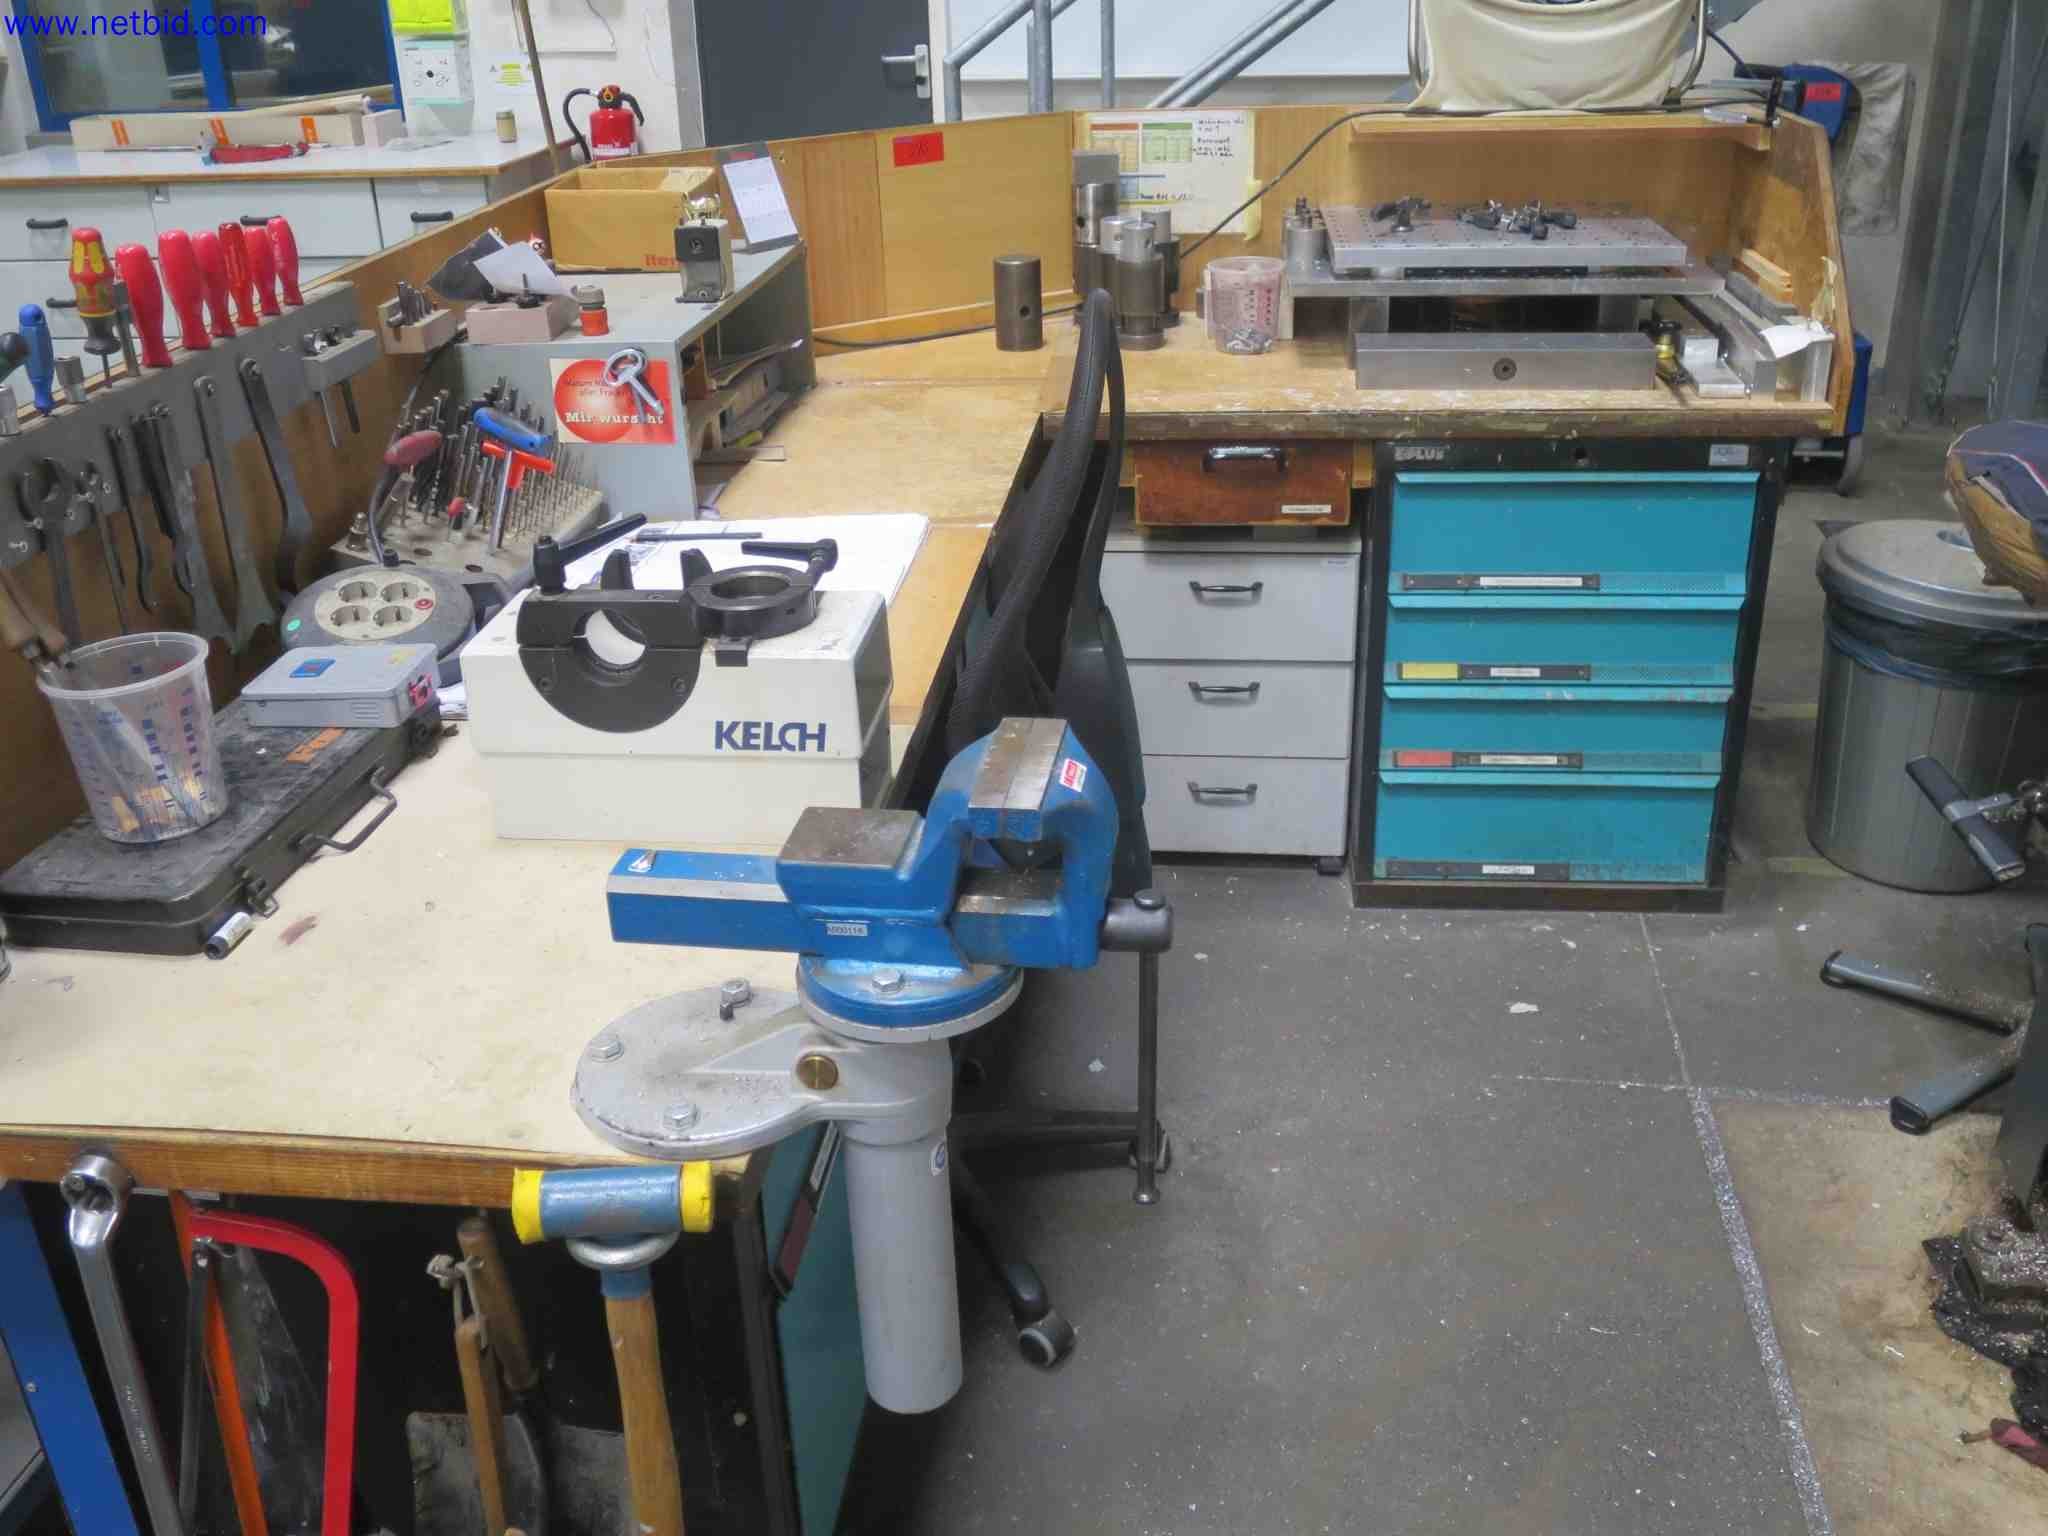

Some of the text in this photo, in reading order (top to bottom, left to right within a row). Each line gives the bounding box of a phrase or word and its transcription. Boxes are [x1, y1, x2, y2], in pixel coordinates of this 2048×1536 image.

[565, 411, 664, 425] Mir wursht
[714, 720, 827, 752] KELCH
